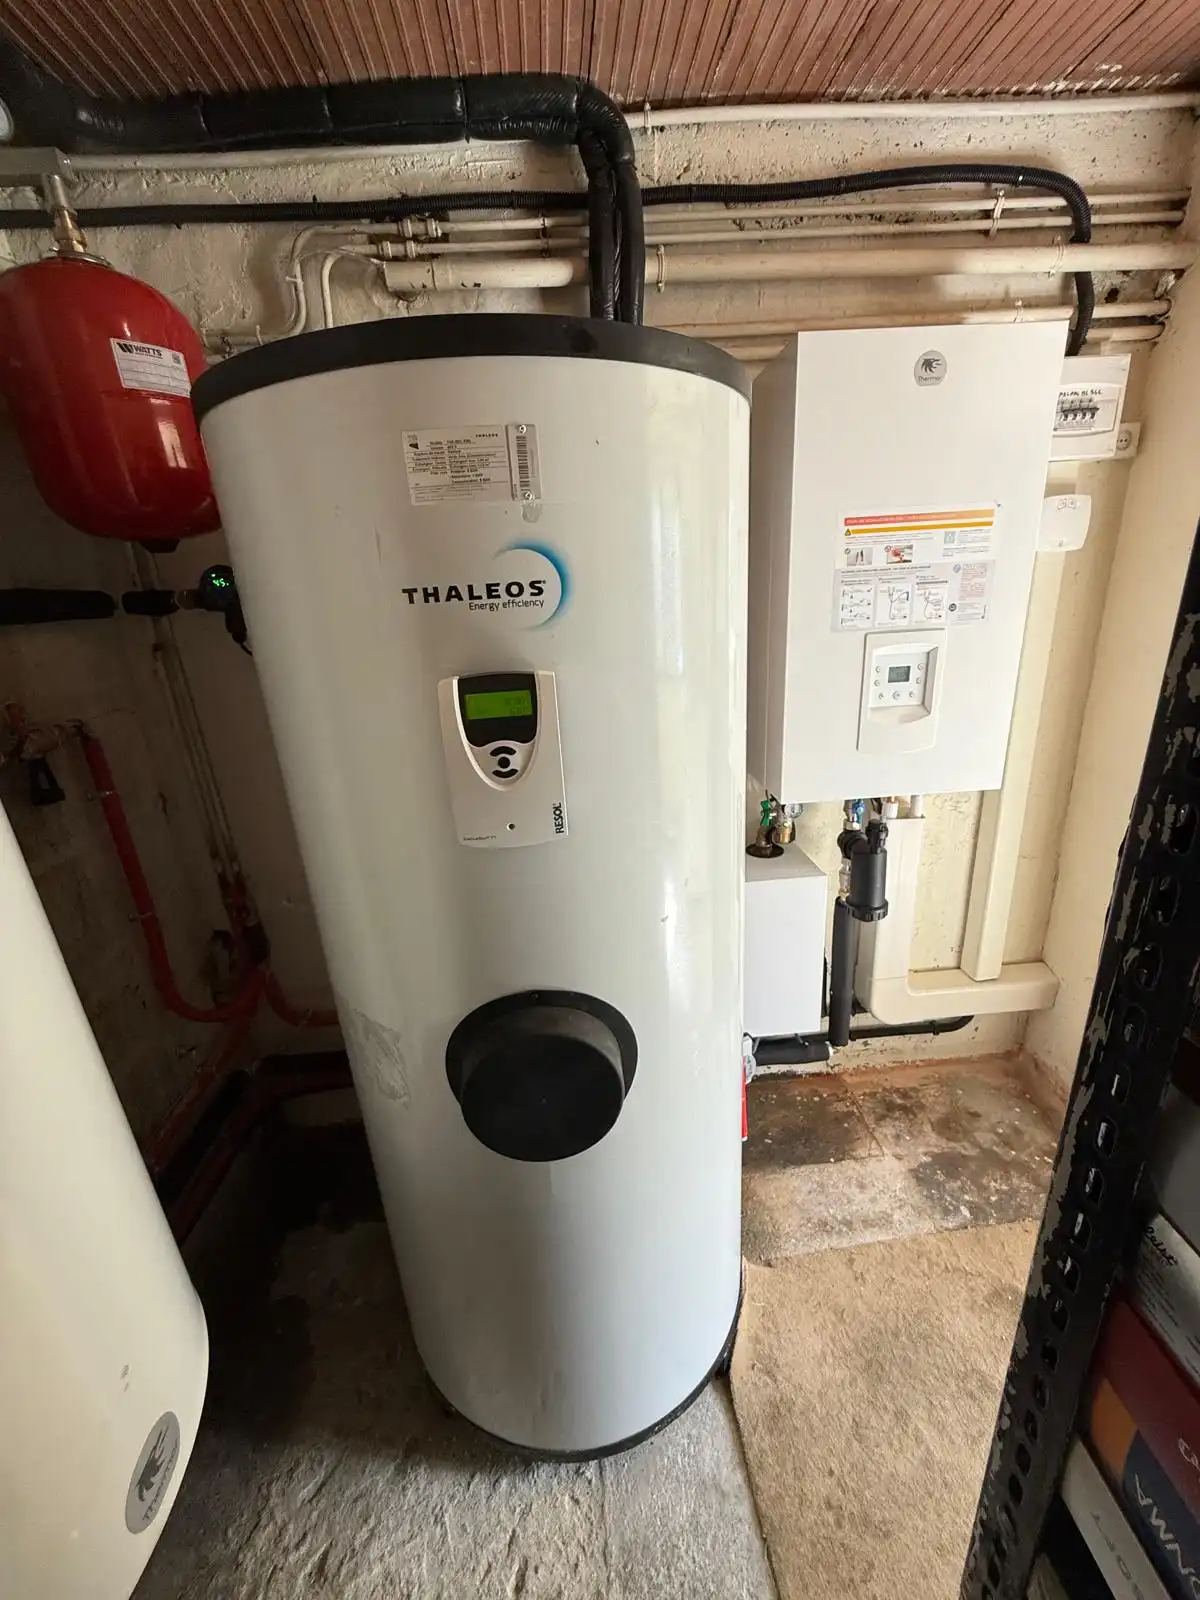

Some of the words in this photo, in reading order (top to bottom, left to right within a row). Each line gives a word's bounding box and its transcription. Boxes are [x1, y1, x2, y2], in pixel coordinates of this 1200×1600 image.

[133, 344, 162, 357] WATTS
[402, 580, 545, 604] THALEOS
[469, 601, 500, 611] Energy
[502, 598, 544, 609] efficiency
[552, 802, 565, 834] RESOL
